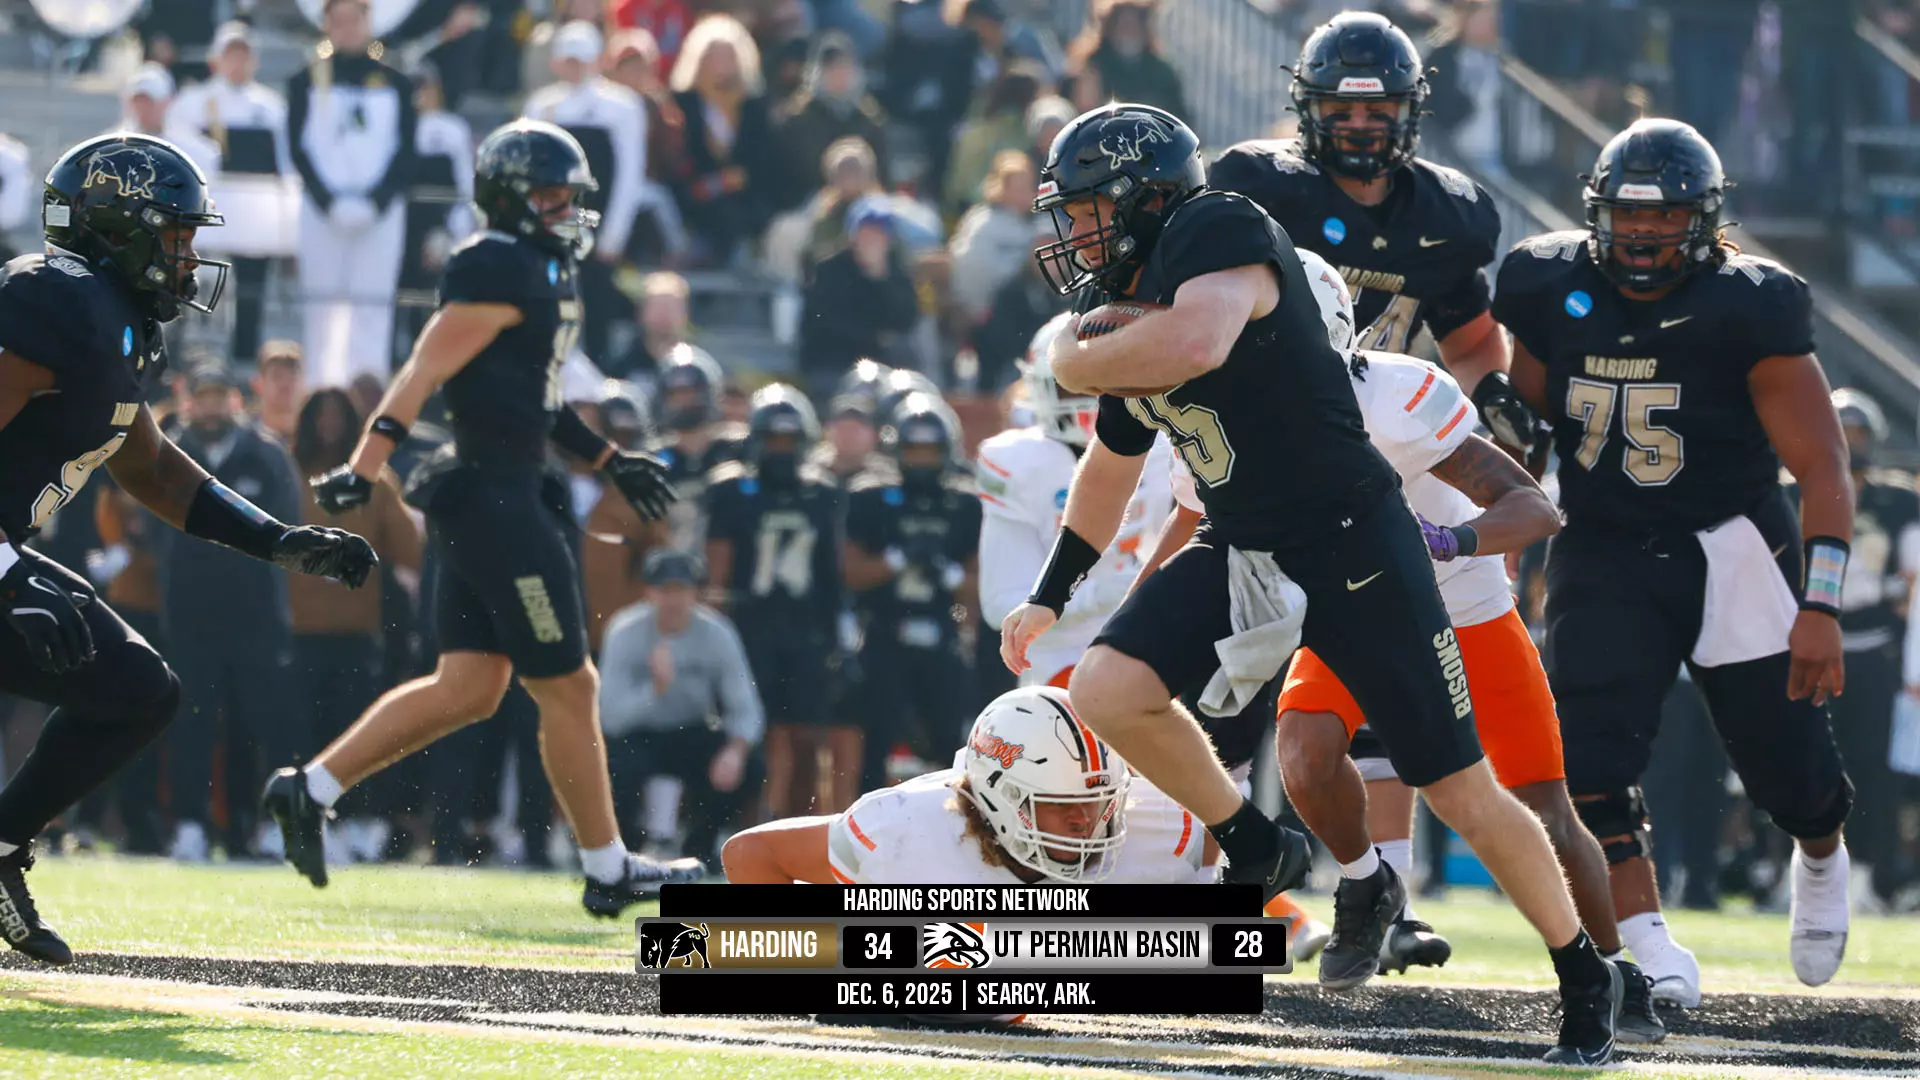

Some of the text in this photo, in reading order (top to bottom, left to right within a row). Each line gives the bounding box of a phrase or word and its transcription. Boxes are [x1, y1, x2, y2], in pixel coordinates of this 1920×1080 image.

[1585, 355, 1657, 380] HARDING
[1566, 377, 1684, 486] 75
[1432, 627, 1472, 720] BISONS
